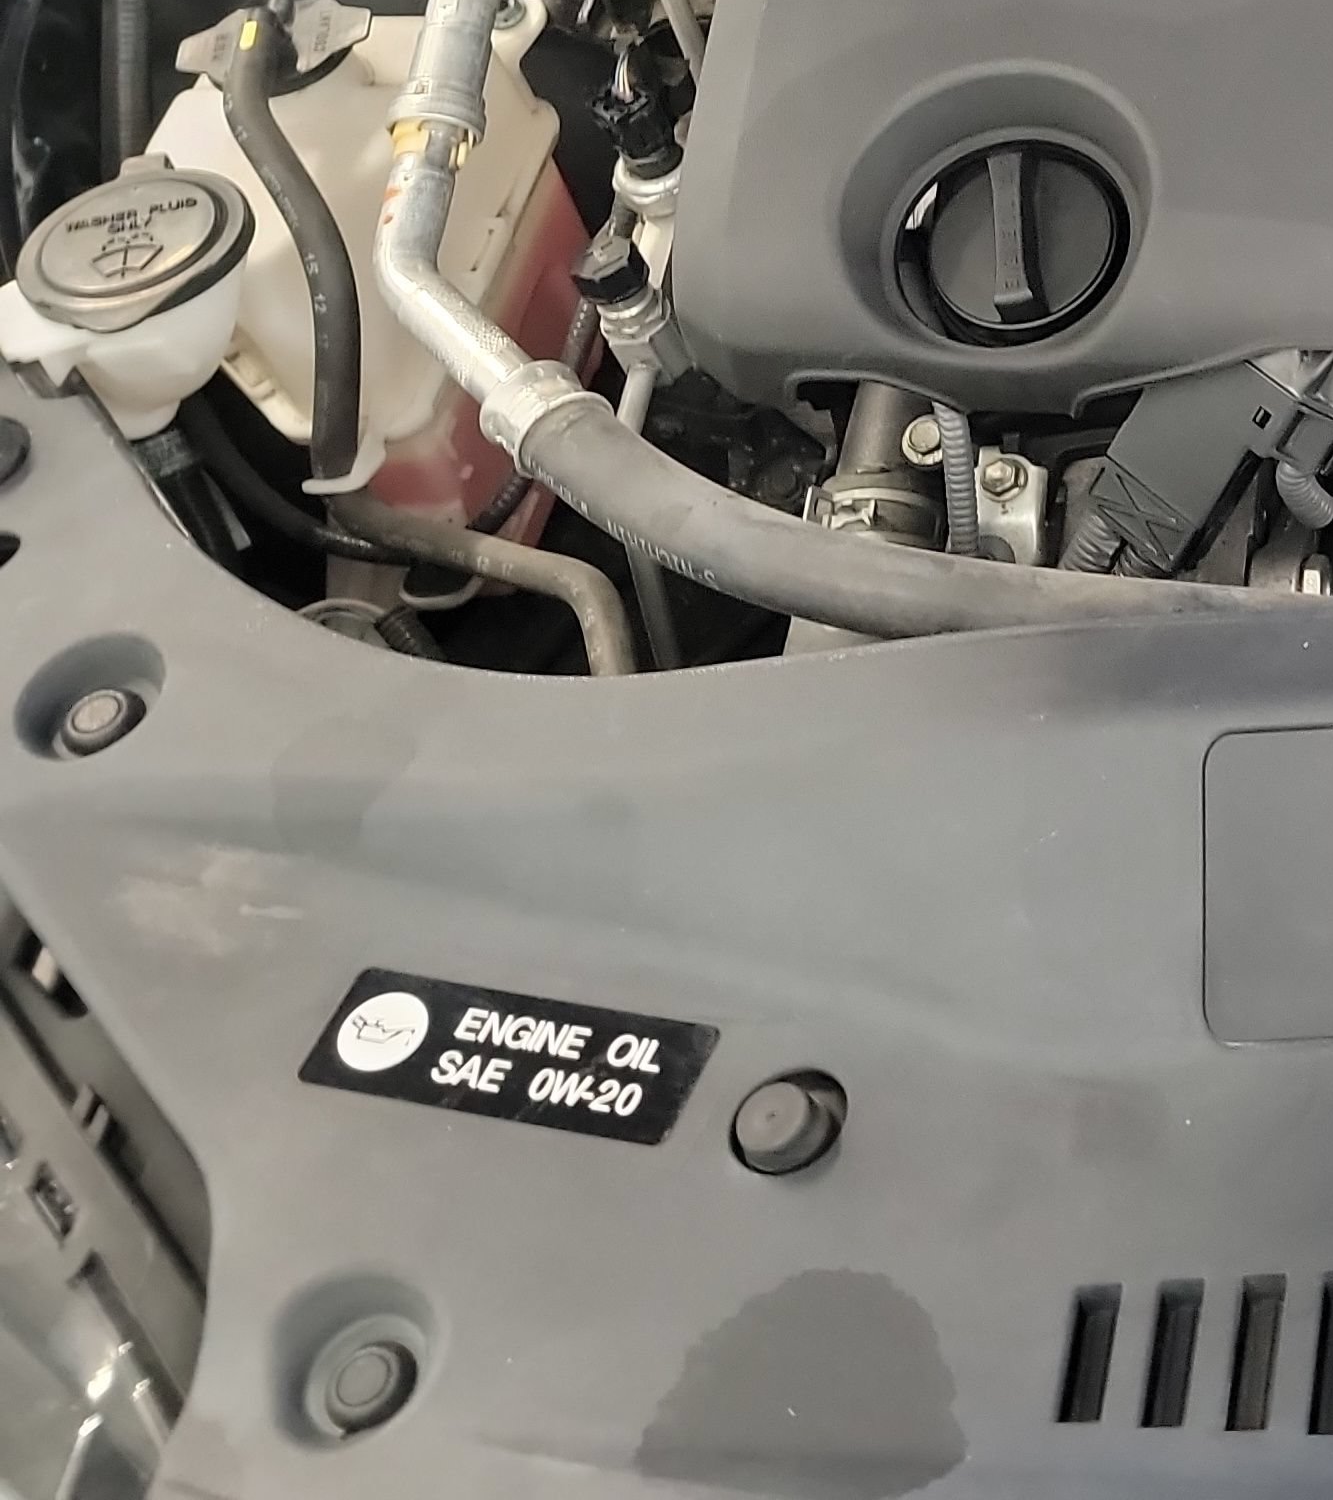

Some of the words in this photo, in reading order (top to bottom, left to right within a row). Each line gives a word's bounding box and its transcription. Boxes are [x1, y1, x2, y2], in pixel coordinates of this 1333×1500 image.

[453, 1007, 592, 1062] ENGINE
[607, 1032, 661, 1074] OIL
[430, 1050, 513, 1094] SAE
[528, 1066, 644, 1118] 0W-20
